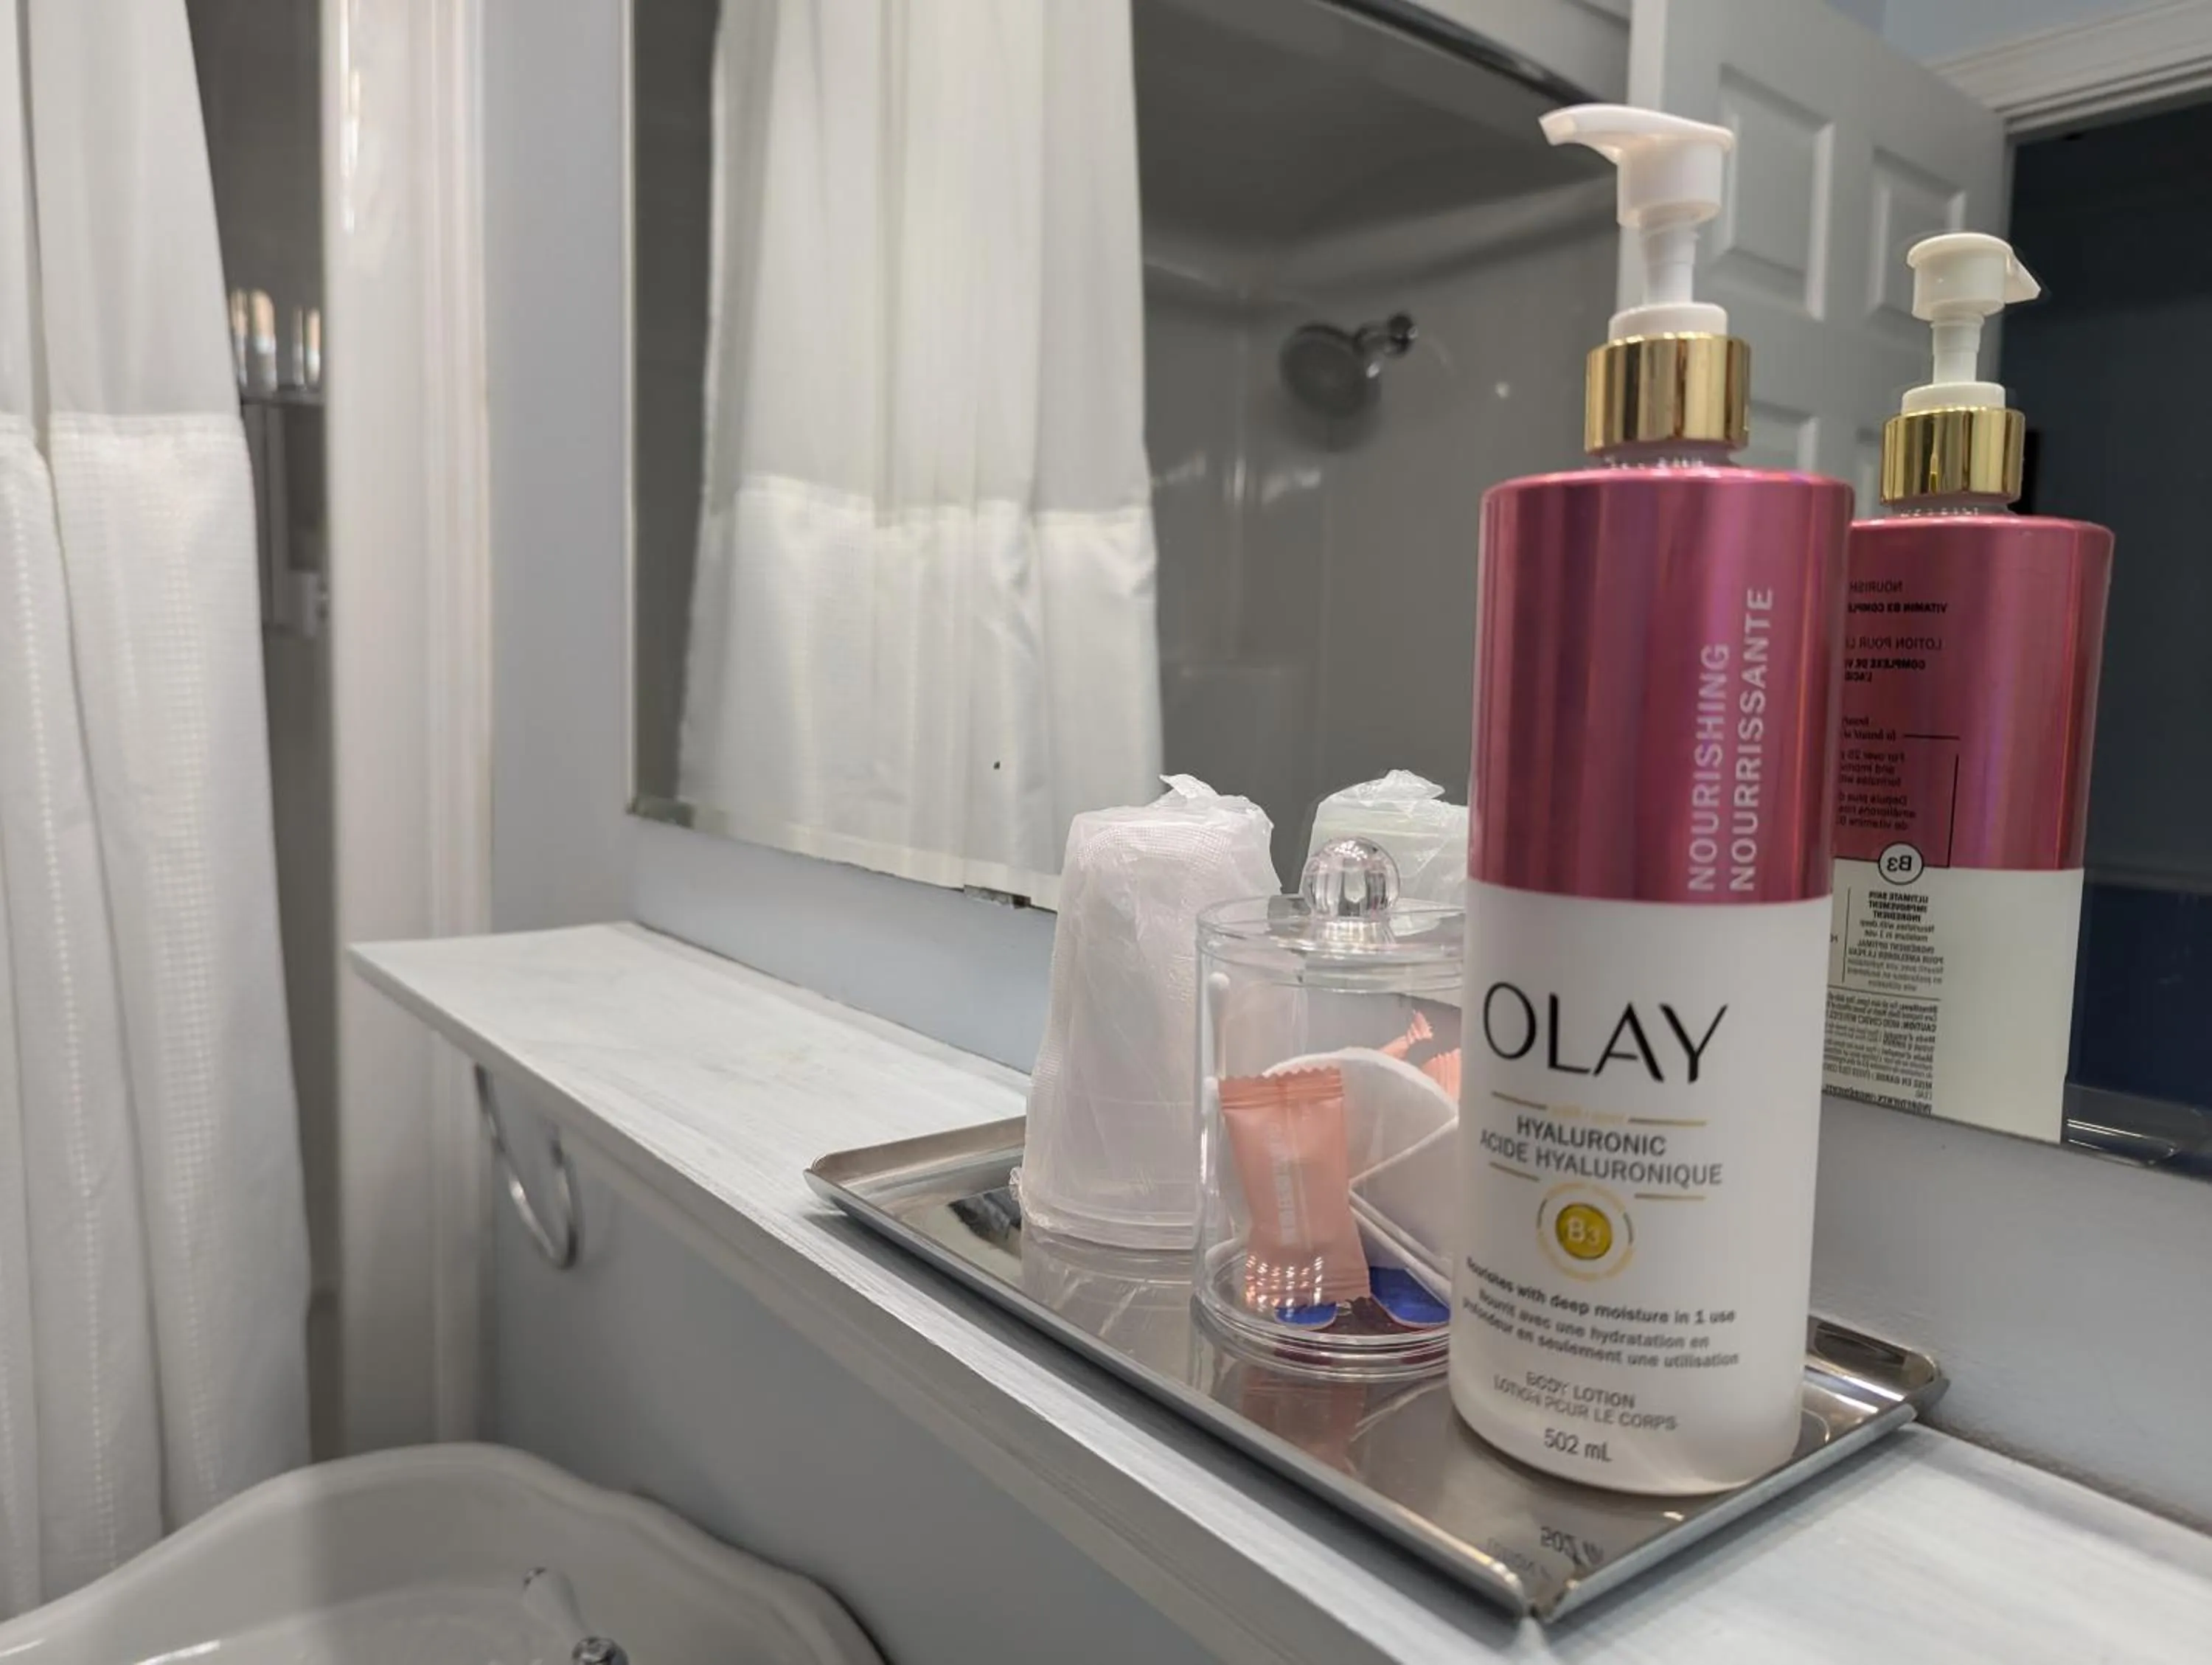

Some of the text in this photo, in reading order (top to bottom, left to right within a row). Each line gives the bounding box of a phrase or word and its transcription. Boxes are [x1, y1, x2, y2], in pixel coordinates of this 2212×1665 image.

[1730, 587, 1773, 891] NOURRISSANTE
[1688, 642, 1731, 891] NOURISHING
[1484, 981, 1728, 1083] OLAY
[1517, 1115, 1666, 1156] HYALURONIC
[1479, 1130, 1723, 1189] ACIDE HYALURONIQUE
[1568, 1217, 1600, 1251] B3
[1517, 1285, 1545, 1304] with
[1550, 1295, 1590, 1316] deep
[1595, 1304, 1669, 1324] moisture
[1674, 1309, 1690, 1324] in
[1695, 1309, 1705, 1324] 1
[1709, 1310, 1736, 1324] use
[1516, 1327, 1534, 1344] en
[1537, 1335, 1622, 1364] seulement
[1627, 1353, 1659, 1367] une
[1664, 1352, 1739, 1369] utilisation
[1519, 1310, 1551, 1329] avec
[1556, 1321, 1586, 1338] une
[1590, 1325, 1686, 1350] hydratation
[1691, 1335, 1709, 1349] en
[1494, 1374, 1679, 1431] LOTION POUR LE CORPS
[1526, 1372, 1636, 1408] BODY LOTION
[1544, 1428, 1613, 1463] 502 mL
